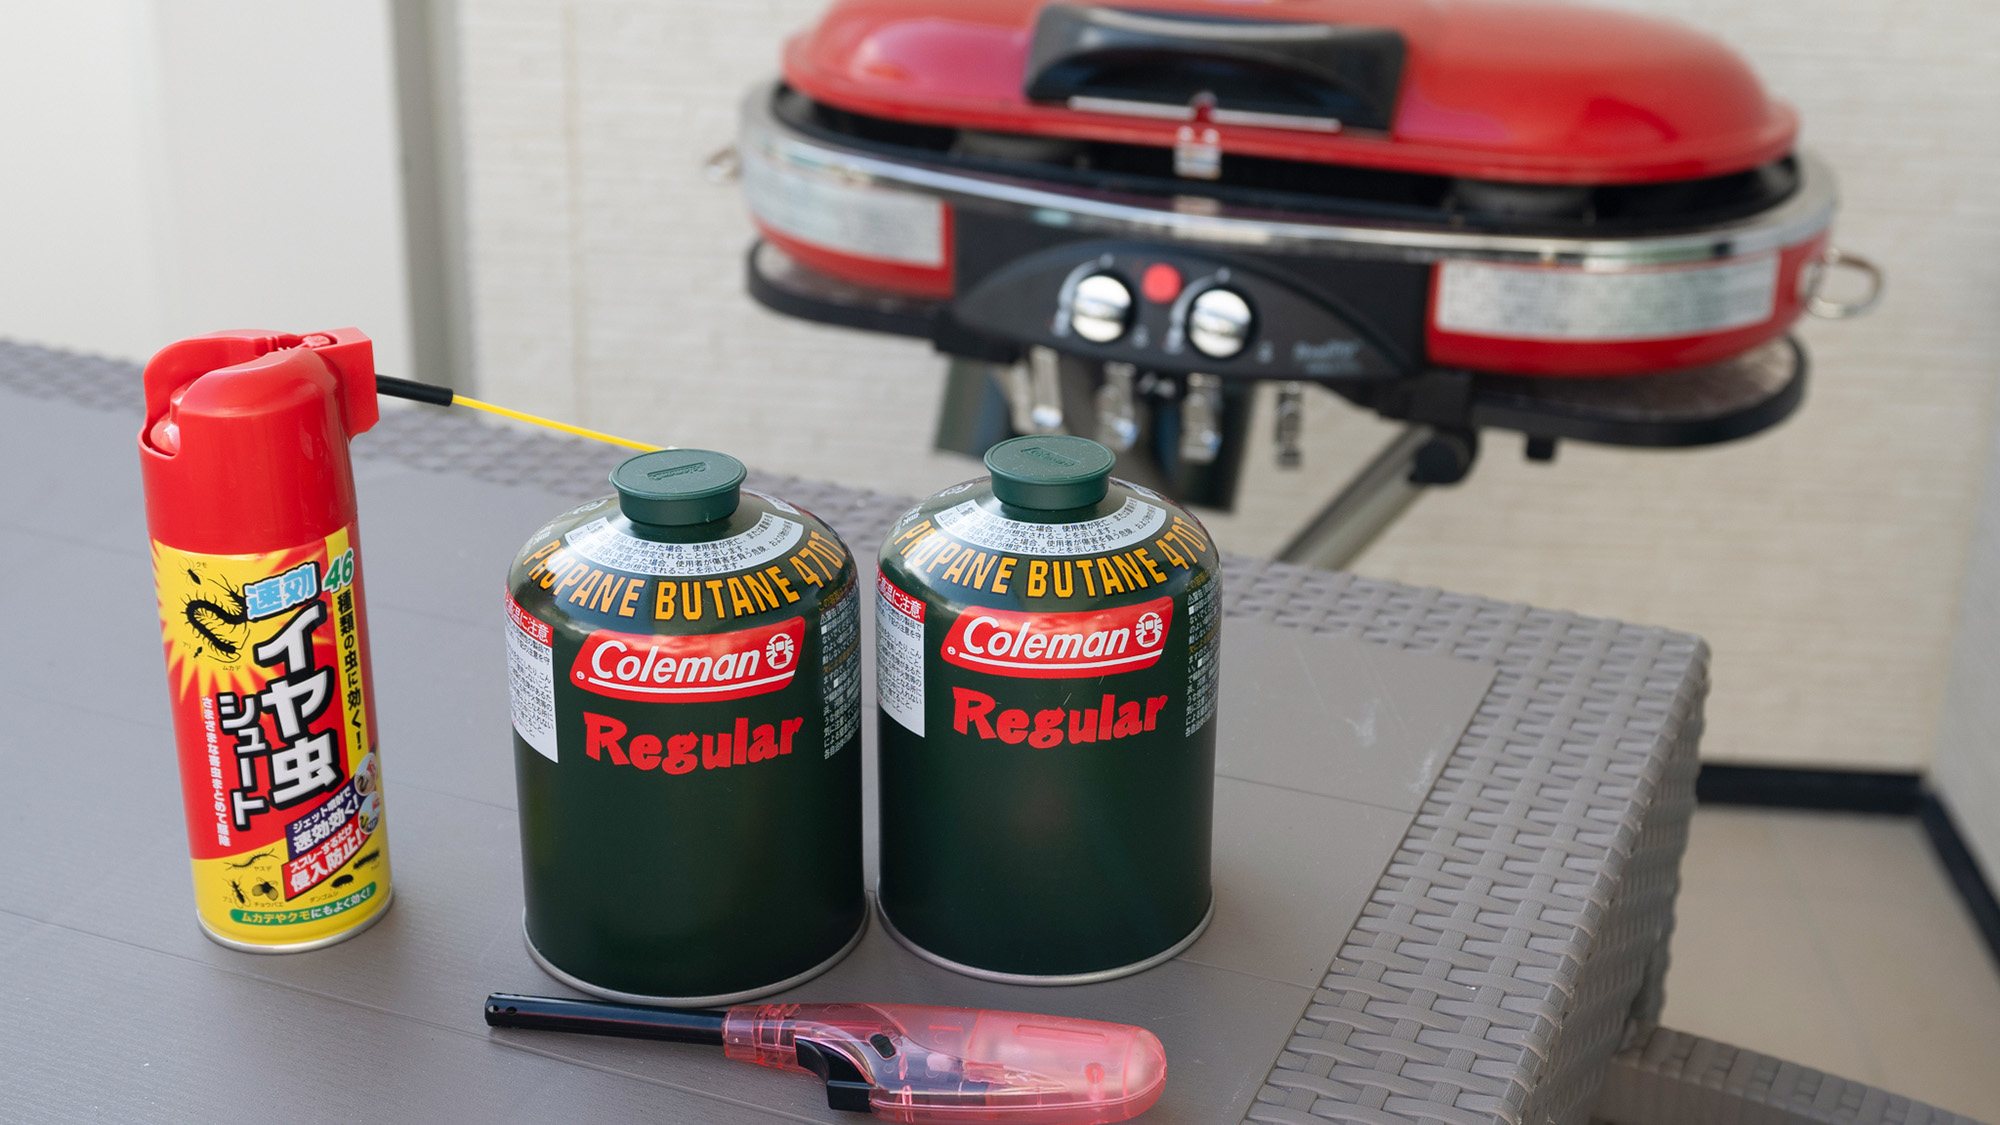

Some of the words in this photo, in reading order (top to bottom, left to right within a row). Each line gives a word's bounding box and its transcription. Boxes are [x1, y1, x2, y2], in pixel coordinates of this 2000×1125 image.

[523, 539, 646, 618] PROPANE
[654, 566, 801, 621] BUTANE
[789, 530, 847, 589] 470T
[894, 519, 1018, 595] PROPANE
[1026, 548, 1168, 598] BUTANE
[1155, 515, 1208, 570] 470T
[245, 564, 316, 620] 速効
[591, 639, 766, 684] Coleman
[962, 616, 1131, 660] Coleman
[257, 605, 337, 804] イヤ虫
[952, 687, 1168, 749] Regular
[219, 694, 267, 826] シュート
[583, 711, 804, 776] Regular
